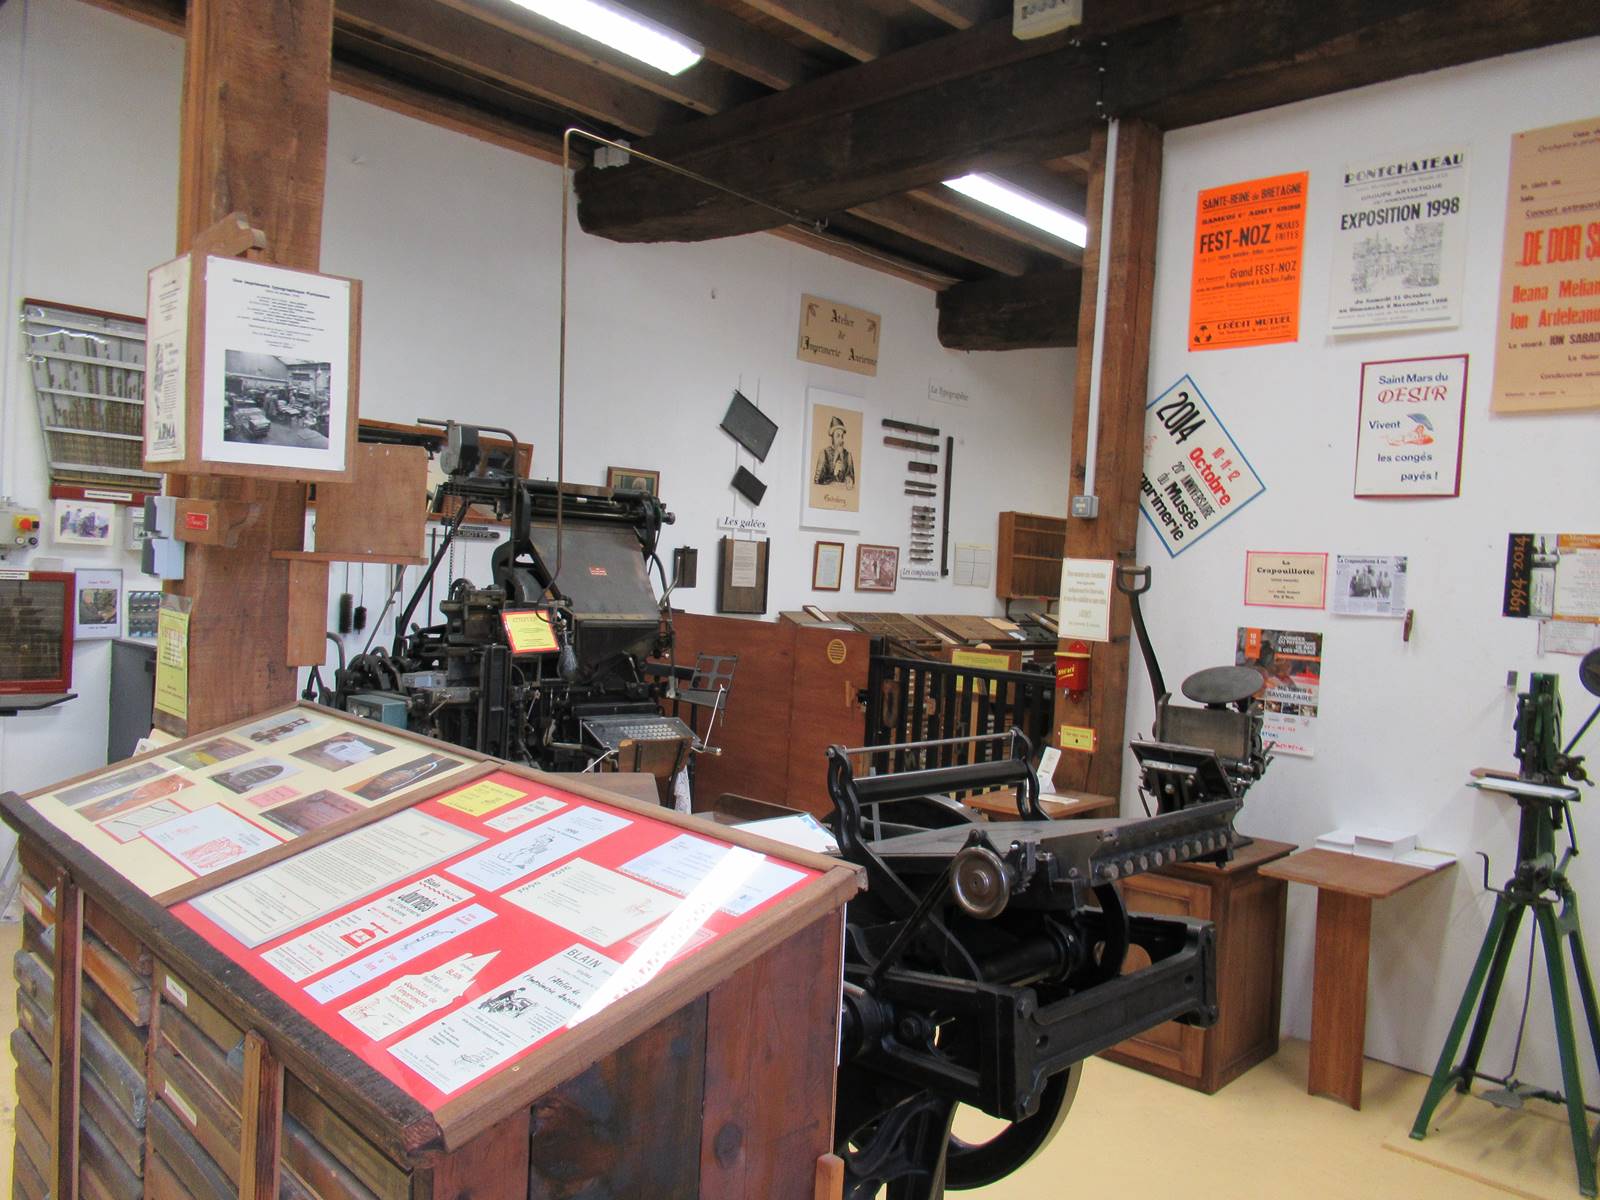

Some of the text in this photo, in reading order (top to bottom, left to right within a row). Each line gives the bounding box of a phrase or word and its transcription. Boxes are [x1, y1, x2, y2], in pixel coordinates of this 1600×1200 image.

[1344, 152, 1464, 184] PONTCHATEAU
[1261, 182, 1301, 199] BRETAGNE
[1340, 203, 1421, 231] EXPOSITION
[1427, 196, 1460, 218] 1998
[1200, 224, 1272, 254] FEST-NOZ
[1255, 260, 1296, 276] FEST-NOZ
[1378, 372, 1448, 385] Saint Mars du
[1377, 385, 1448, 404] DESIR
[1156, 391, 1206, 444] 2014
[1368, 420, 1400, 430] Vivent
[1378, 451, 1432, 463] les congés
[1189, 447, 1231, 506] Octobre
[1400, 472, 1432, 482] payés
[1164, 481, 1199, 530] Musée
[724, 516, 766, 529] Les galées
[567, 948, 602, 968] BLAIN
